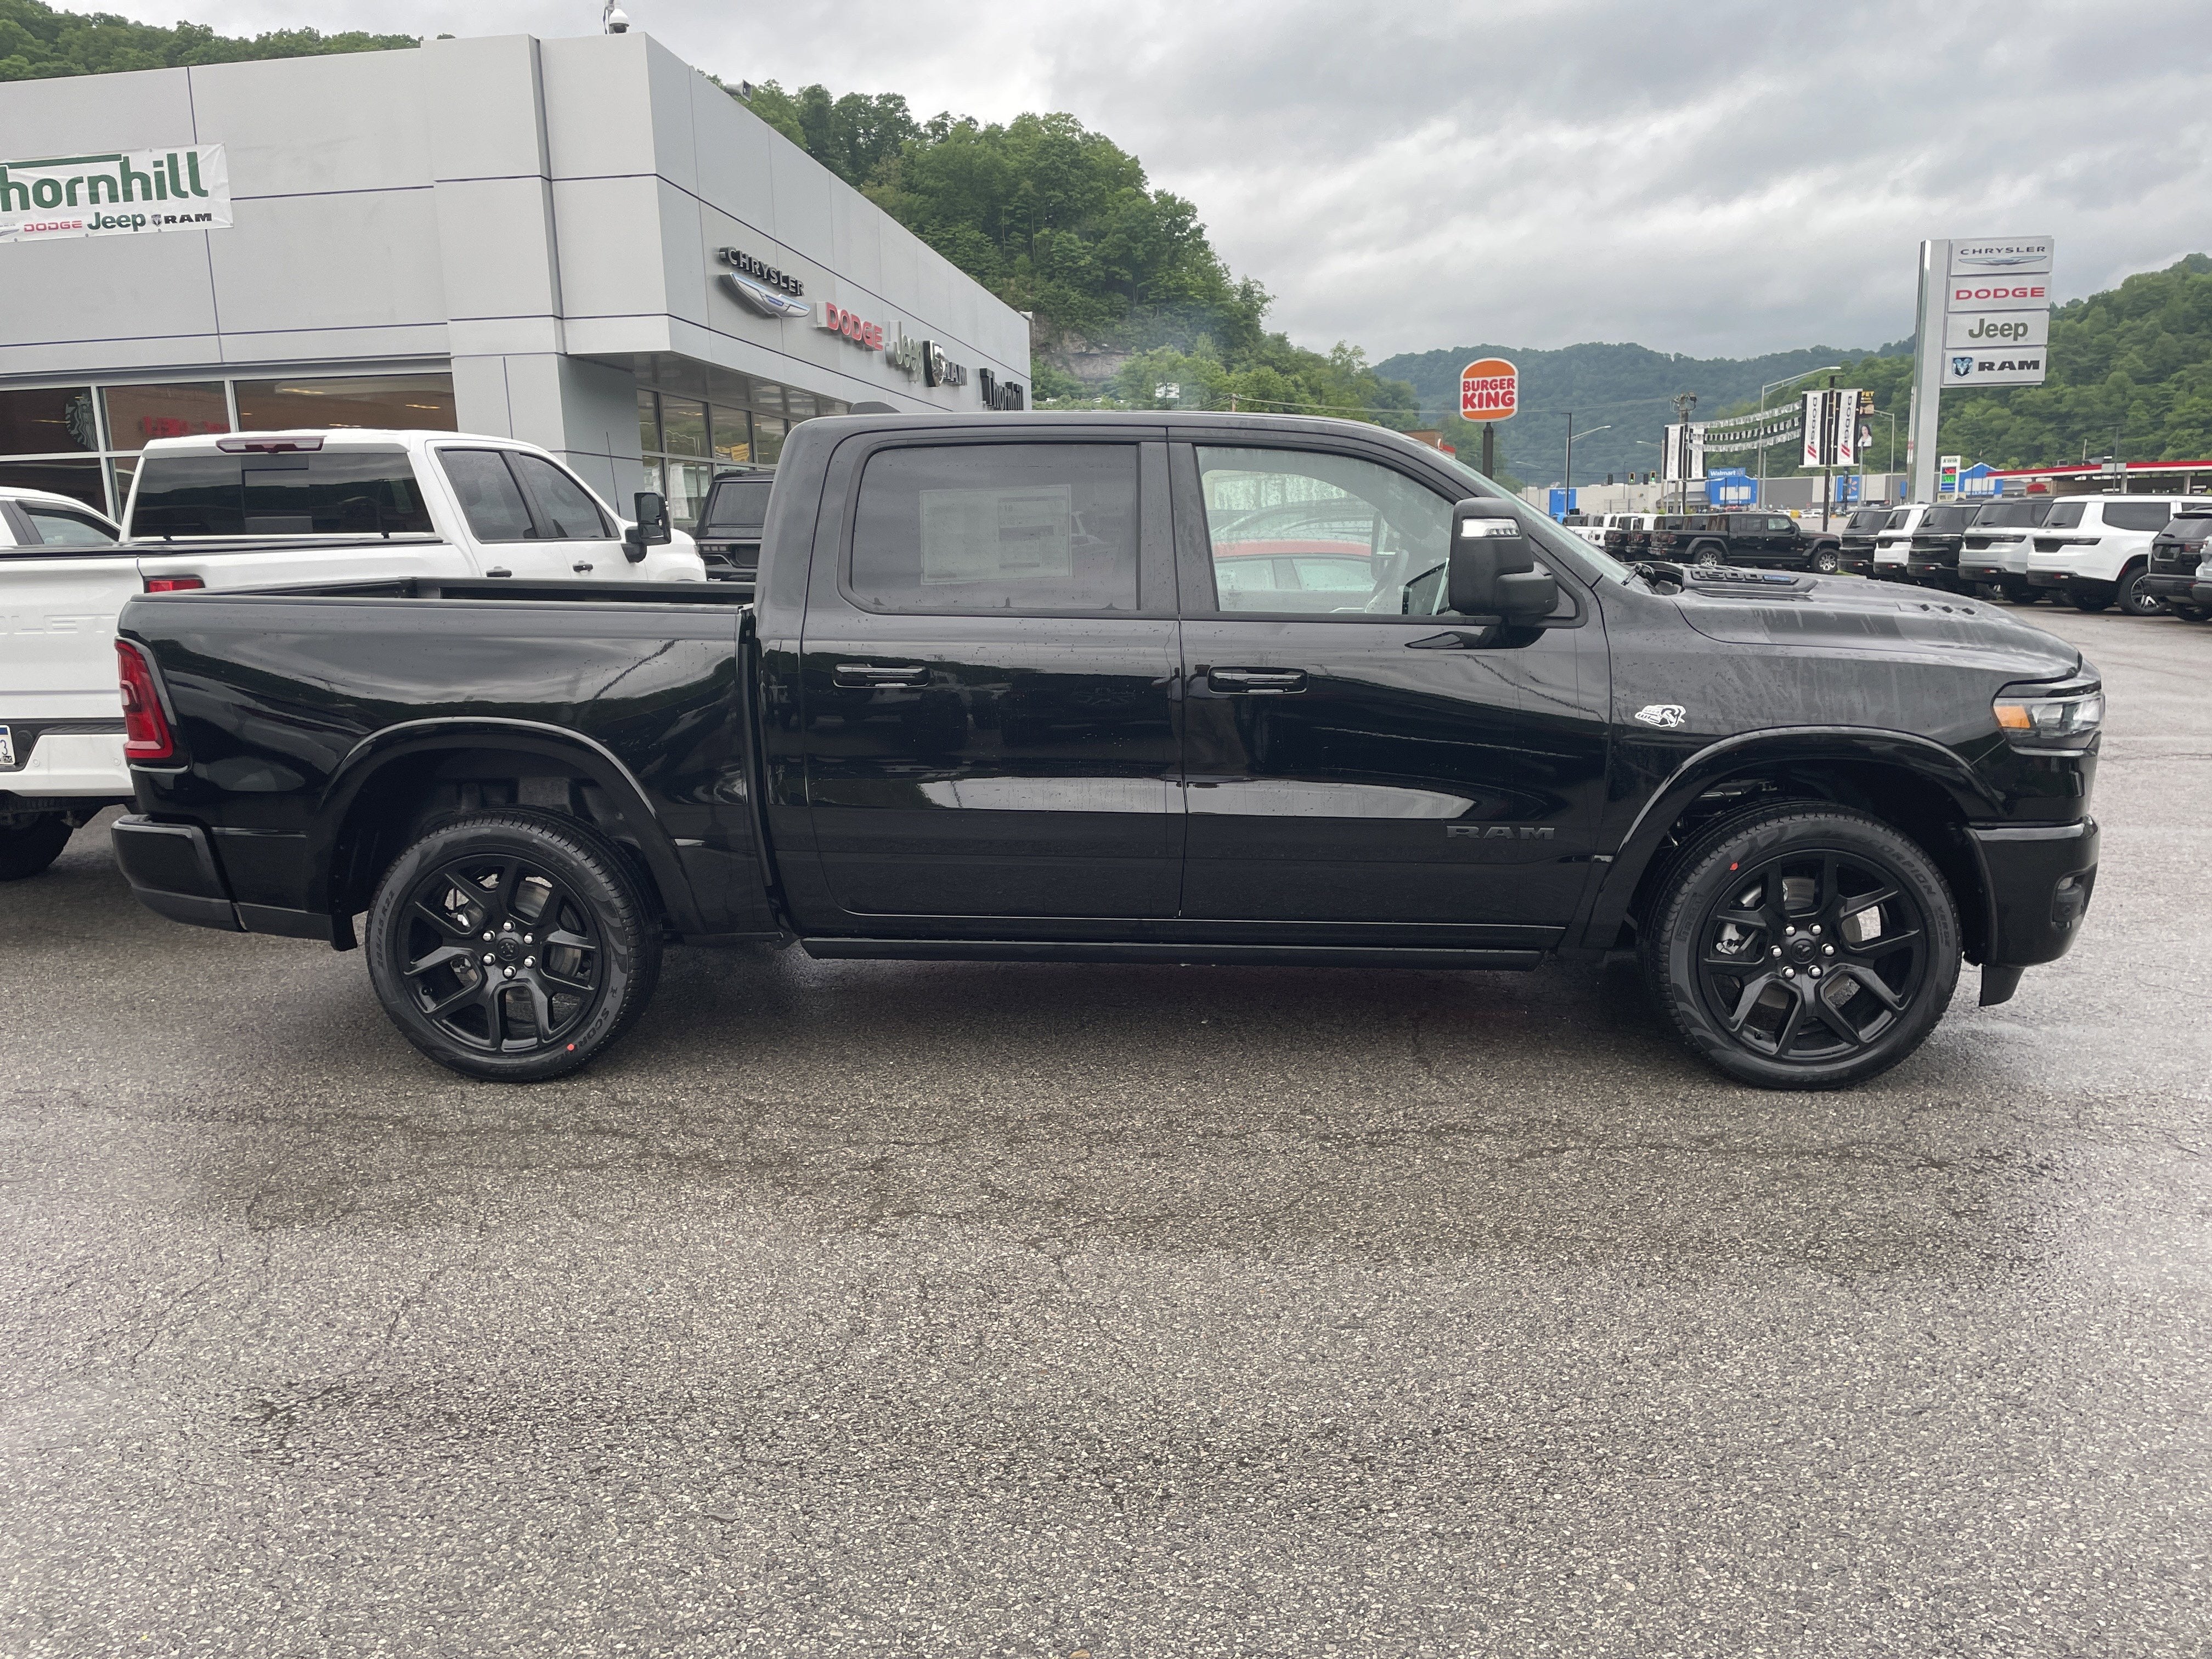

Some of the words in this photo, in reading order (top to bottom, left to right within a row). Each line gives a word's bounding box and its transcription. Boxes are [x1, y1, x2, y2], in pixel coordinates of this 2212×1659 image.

[24, 220, 82, 232] DODGE
[87, 212, 146, 232] Jeep
[164, 213, 212, 224] RAM
[1960, 246, 2045, 255] CHRYSLER
[720, 246, 805, 296] CHRYSLER
[1955, 287, 2045, 300] DODGE
[826, 301, 883, 351] DODGE
[1968, 318, 2028, 341] Jeep
[886, 320, 923, 379] Jeep
[943, 358, 967, 386] RAM
[1978, 360, 2040, 371] RAM
[979, 368, 1024, 410] Thornhill
[1463, 378, 1515, 392] BURGER
[1463, 391, 1515, 409] KING
[1446, 825, 1555, 840] RAM
